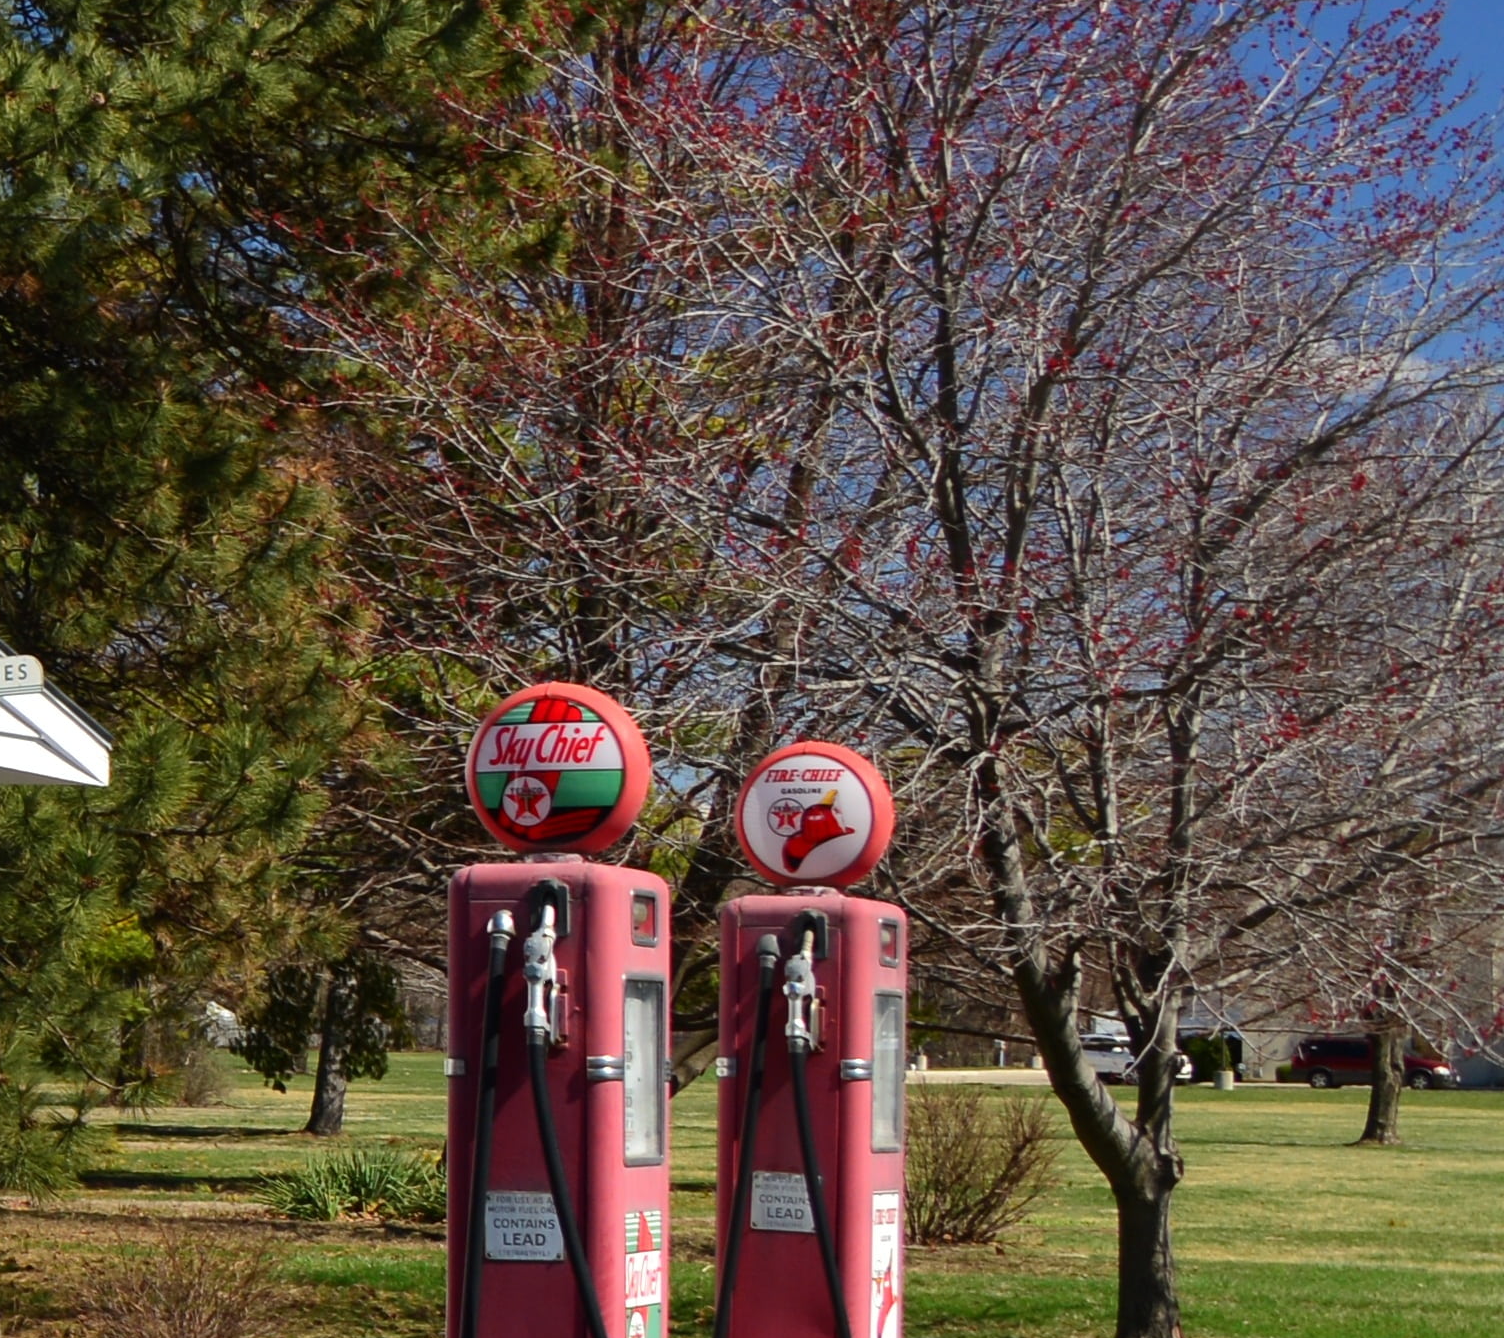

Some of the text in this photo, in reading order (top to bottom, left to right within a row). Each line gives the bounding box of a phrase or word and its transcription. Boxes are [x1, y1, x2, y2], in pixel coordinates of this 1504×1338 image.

[489, 724, 605, 769] Sky Chief
[764, 768, 846, 783] FIRE-CHIEF
[780, 787, 822, 795] GASOLINE
[767, 1207, 804, 1220] LEAD
[493, 1218, 556, 1230] CONTAINS
[503, 1232, 546, 1246] LEAD
